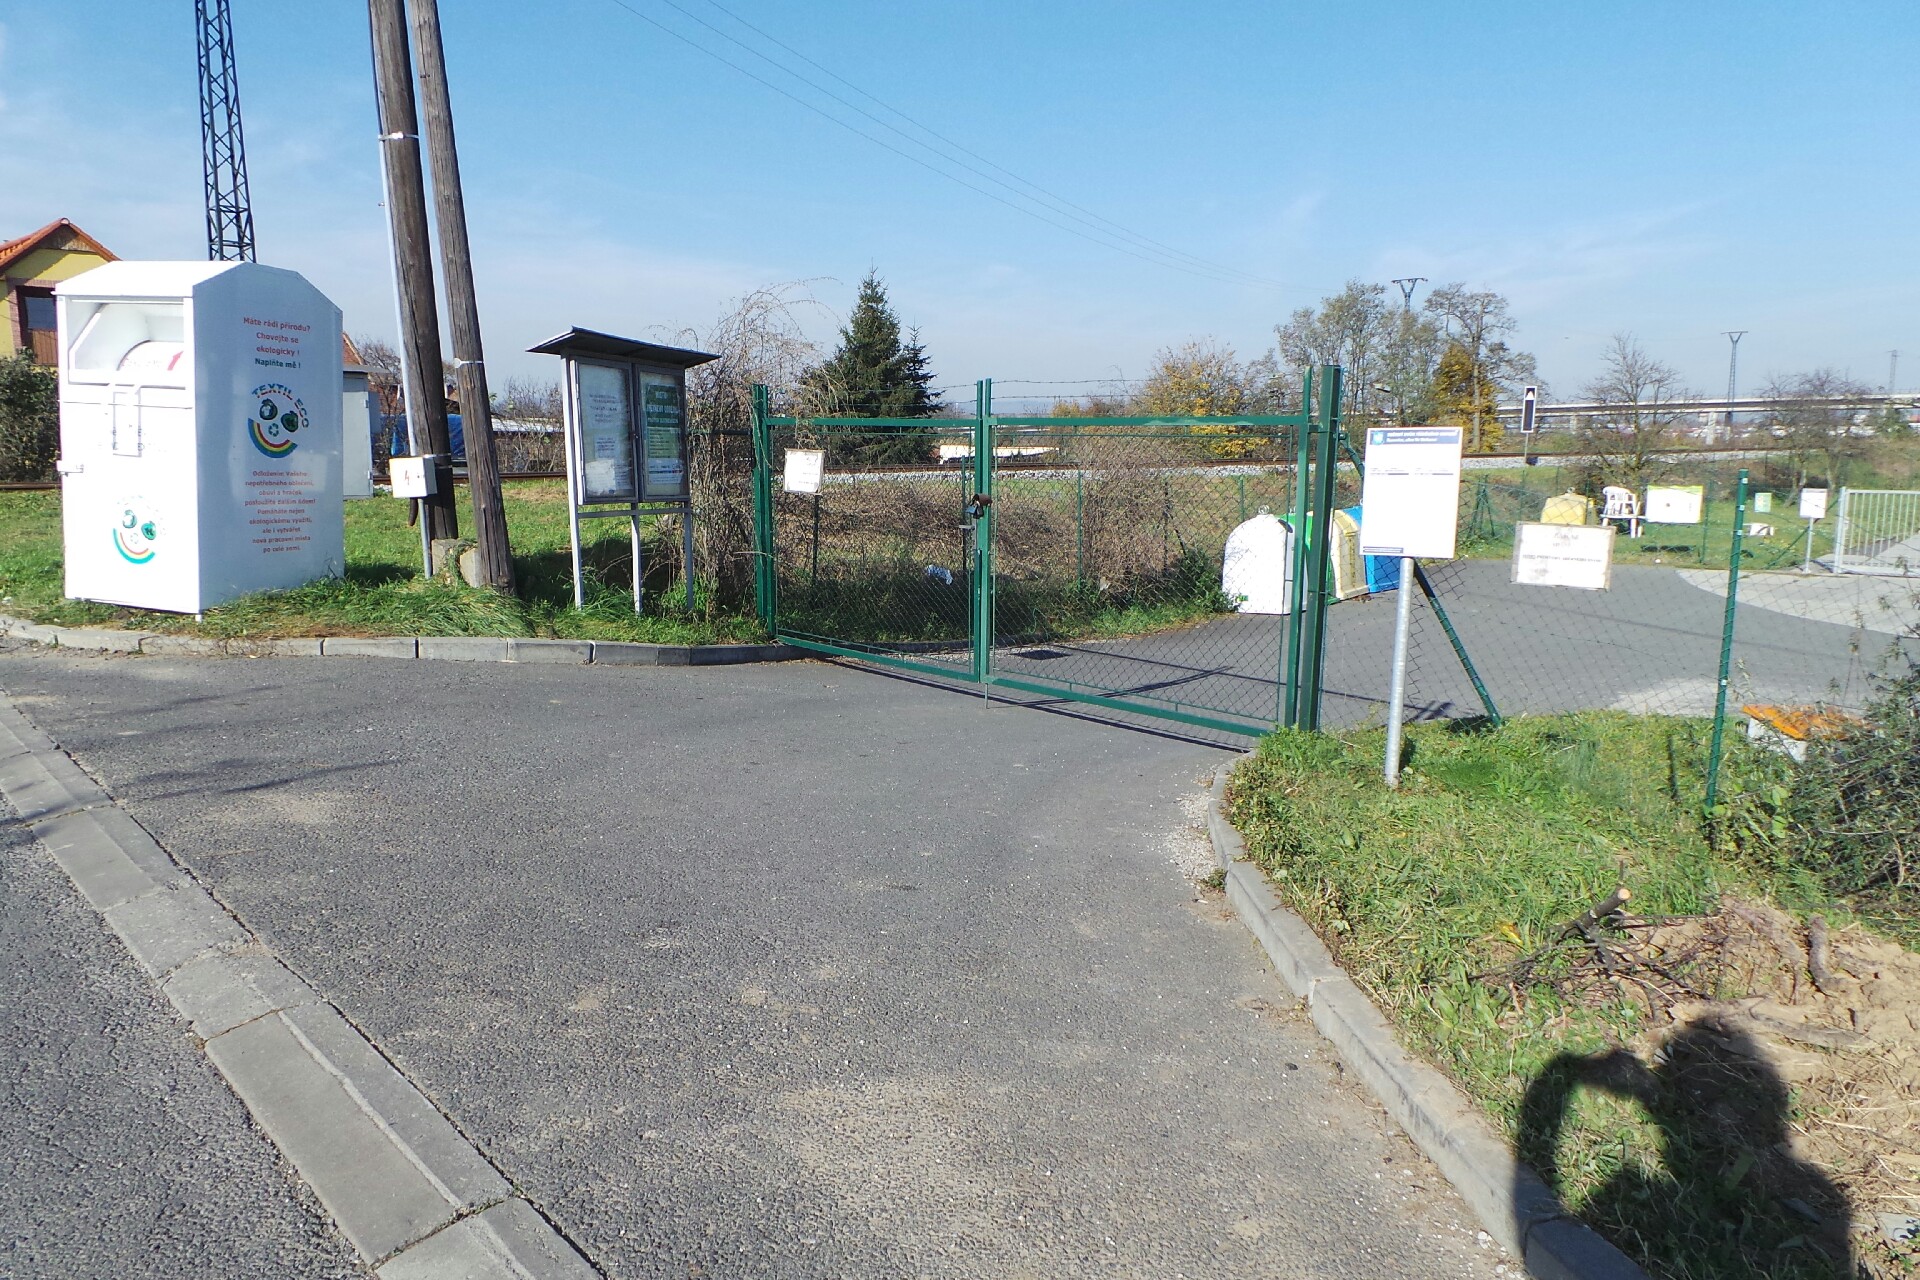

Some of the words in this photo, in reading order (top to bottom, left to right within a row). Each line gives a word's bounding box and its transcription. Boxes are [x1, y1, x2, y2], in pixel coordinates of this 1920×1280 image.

[243, 316, 262, 326] Máte
[263, 319, 278, 328] rádi
[280, 321, 311, 333] přírodu?
[256, 331, 289, 343] Chovejte
[256, 346, 295, 357] ekologicky
[255, 357, 284, 367] Naplňte
[285, 361, 297, 369] mě
[252, 383, 294, 401] TEXTIL
[294, 398, 310, 429] ECO
